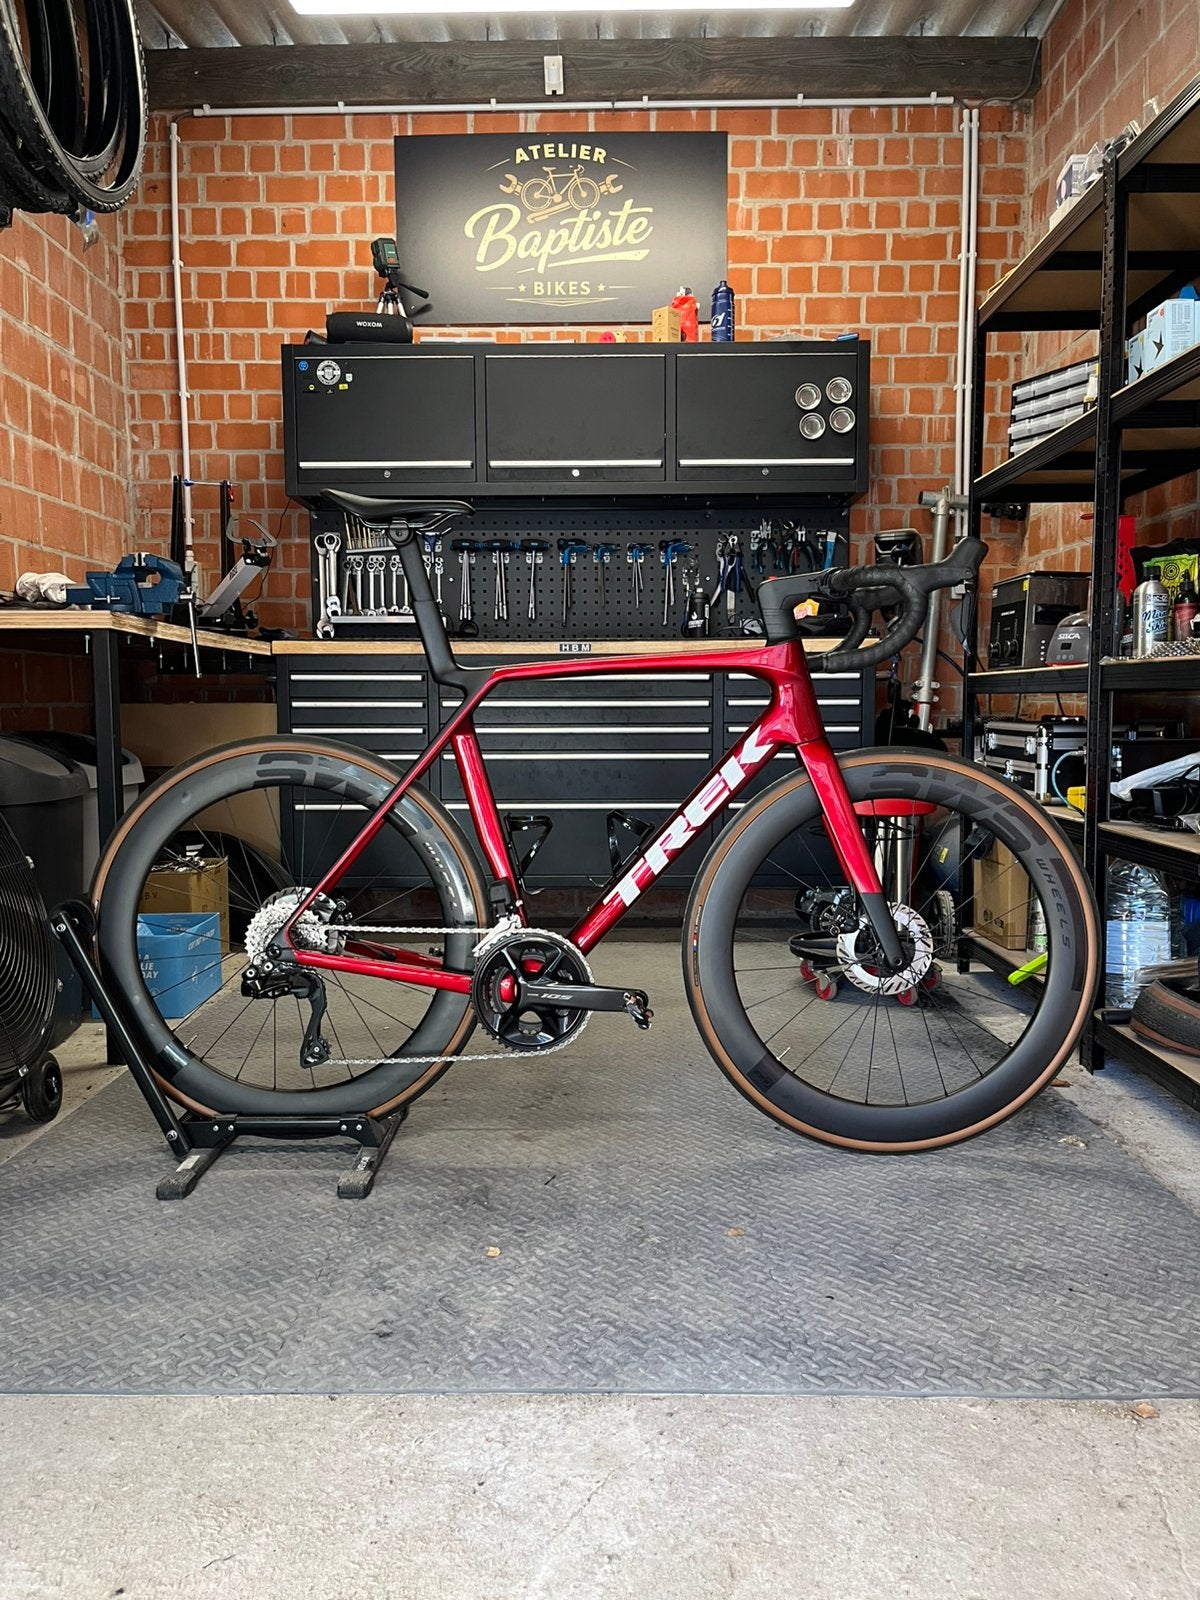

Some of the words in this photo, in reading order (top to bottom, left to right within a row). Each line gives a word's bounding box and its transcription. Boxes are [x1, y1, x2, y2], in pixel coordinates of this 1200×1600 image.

[514, 142, 608, 164] ATELIER
[464, 199, 654, 274] Baptiste
[533, 281, 591, 296] BIKES
[356, 320, 383, 328] WOXOM
[560, 643, 591, 652] HBM
[603, 726, 775, 907] TREK
[1035, 857, 1071, 951] WHEELS
[540, 992, 574, 1000] 105
